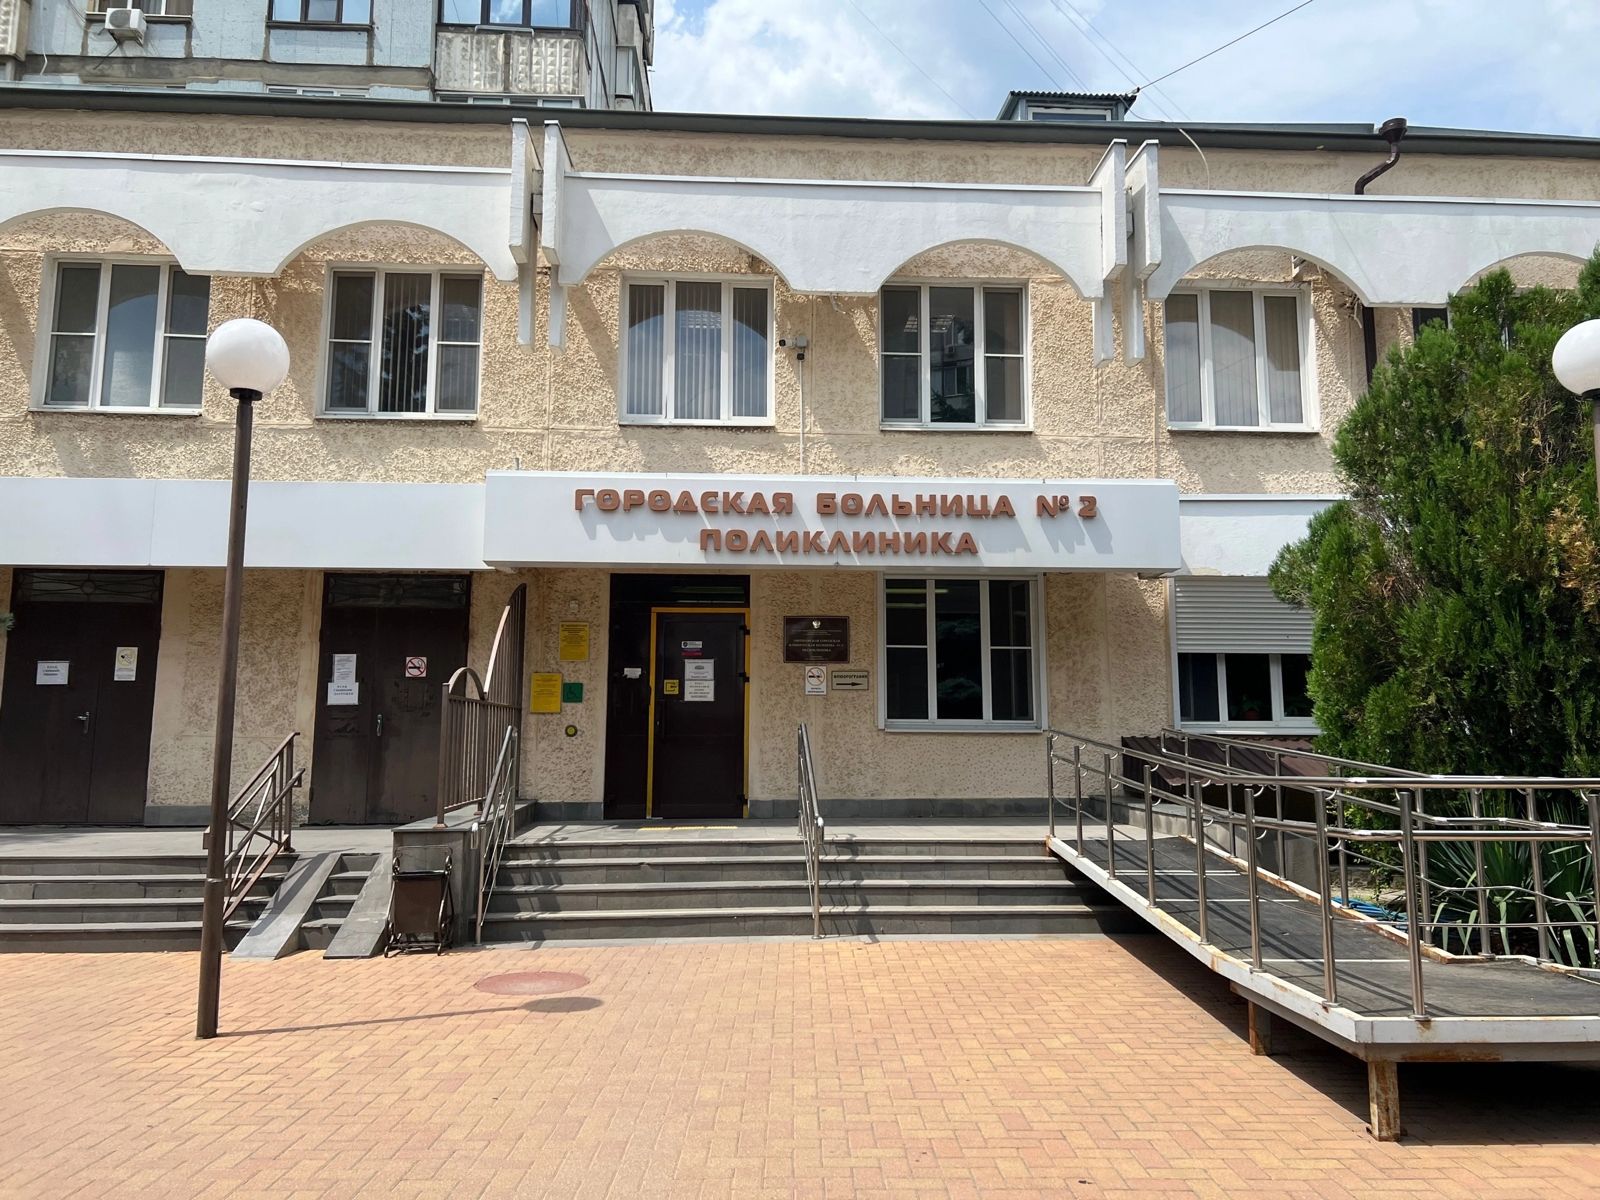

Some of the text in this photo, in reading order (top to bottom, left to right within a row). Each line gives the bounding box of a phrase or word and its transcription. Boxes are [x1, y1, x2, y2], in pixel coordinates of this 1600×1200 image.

[574, 488, 793, 515] ГОРОДСКАЯ
[816, 492, 1016, 518] БОЛЬНИЦА
[700, 528, 978, 554] ПОЛИКЛИНИКА
